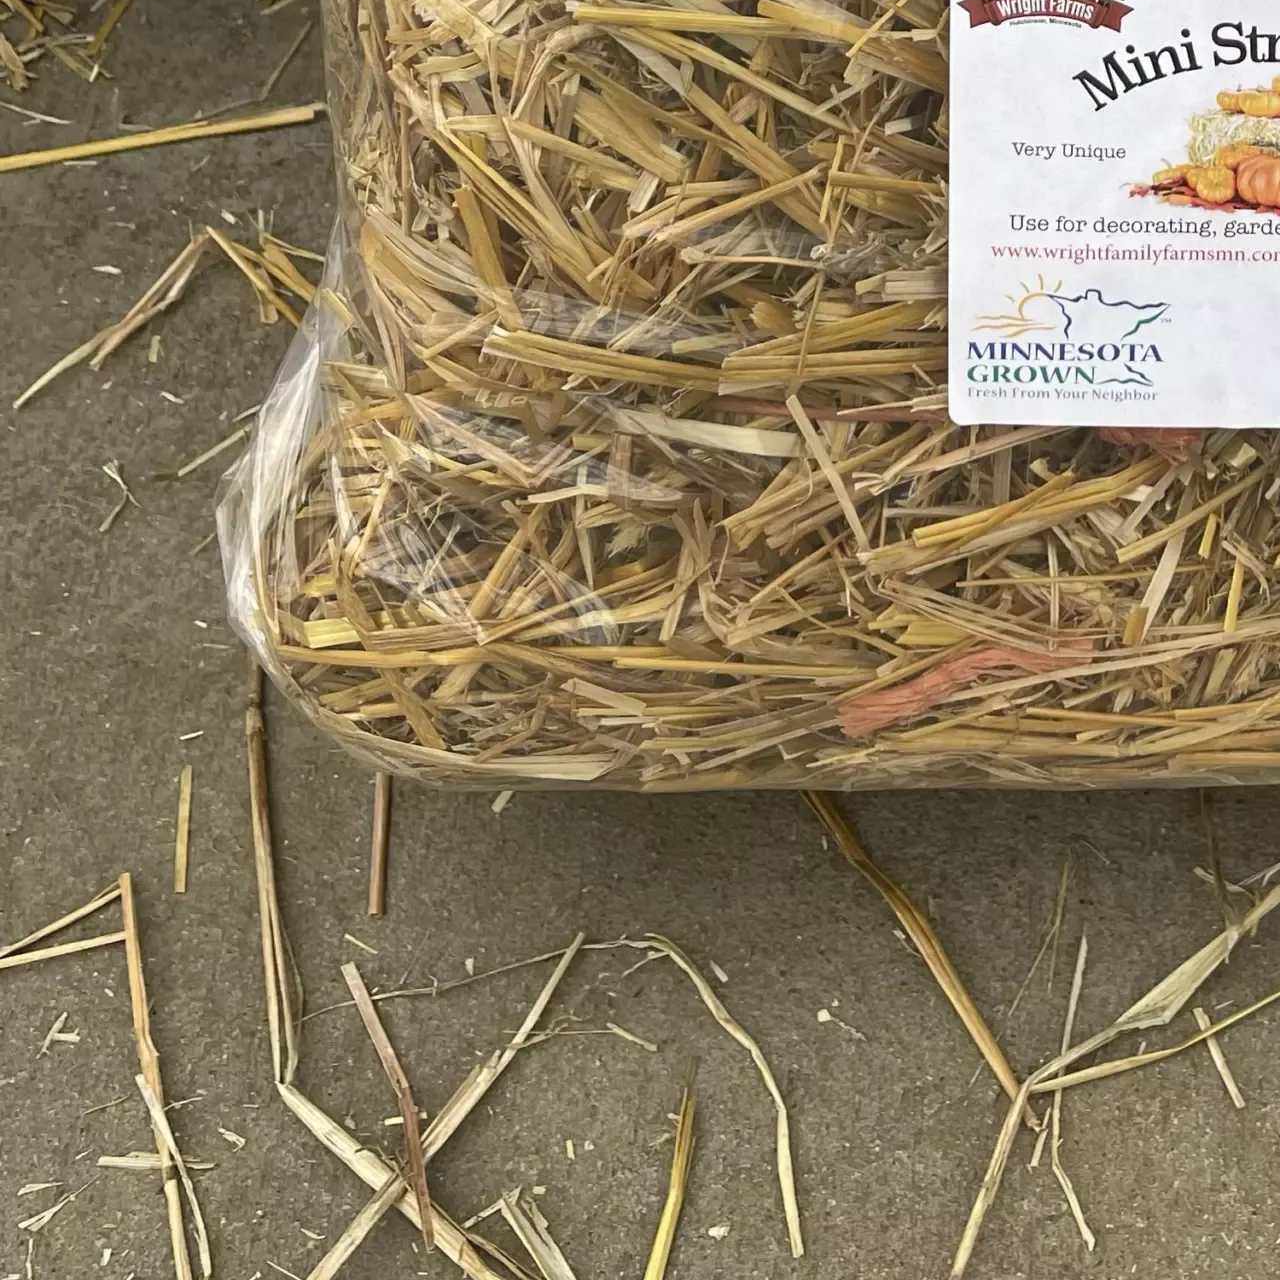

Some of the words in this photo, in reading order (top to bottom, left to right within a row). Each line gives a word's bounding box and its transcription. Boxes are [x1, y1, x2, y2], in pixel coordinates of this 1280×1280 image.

[1072, 28, 1203, 112] Mini
[1011, 142, 1056, 160] Very
[1062, 143, 1126, 162] Unique
[1009, 214, 1049, 233] Use
[1055, 216, 1087, 233] for
[1093, 216, 1217, 239] decorating,
[967, 341, 1164, 362] MINNESOTA
[967, 364, 1098, 384] GROWN
[968, 387, 1008, 399] Fresh
[1012, 388, 1050, 400] From
[1054, 389, 1088, 400] Your
[1092, 388, 1159, 402] Neighbor
